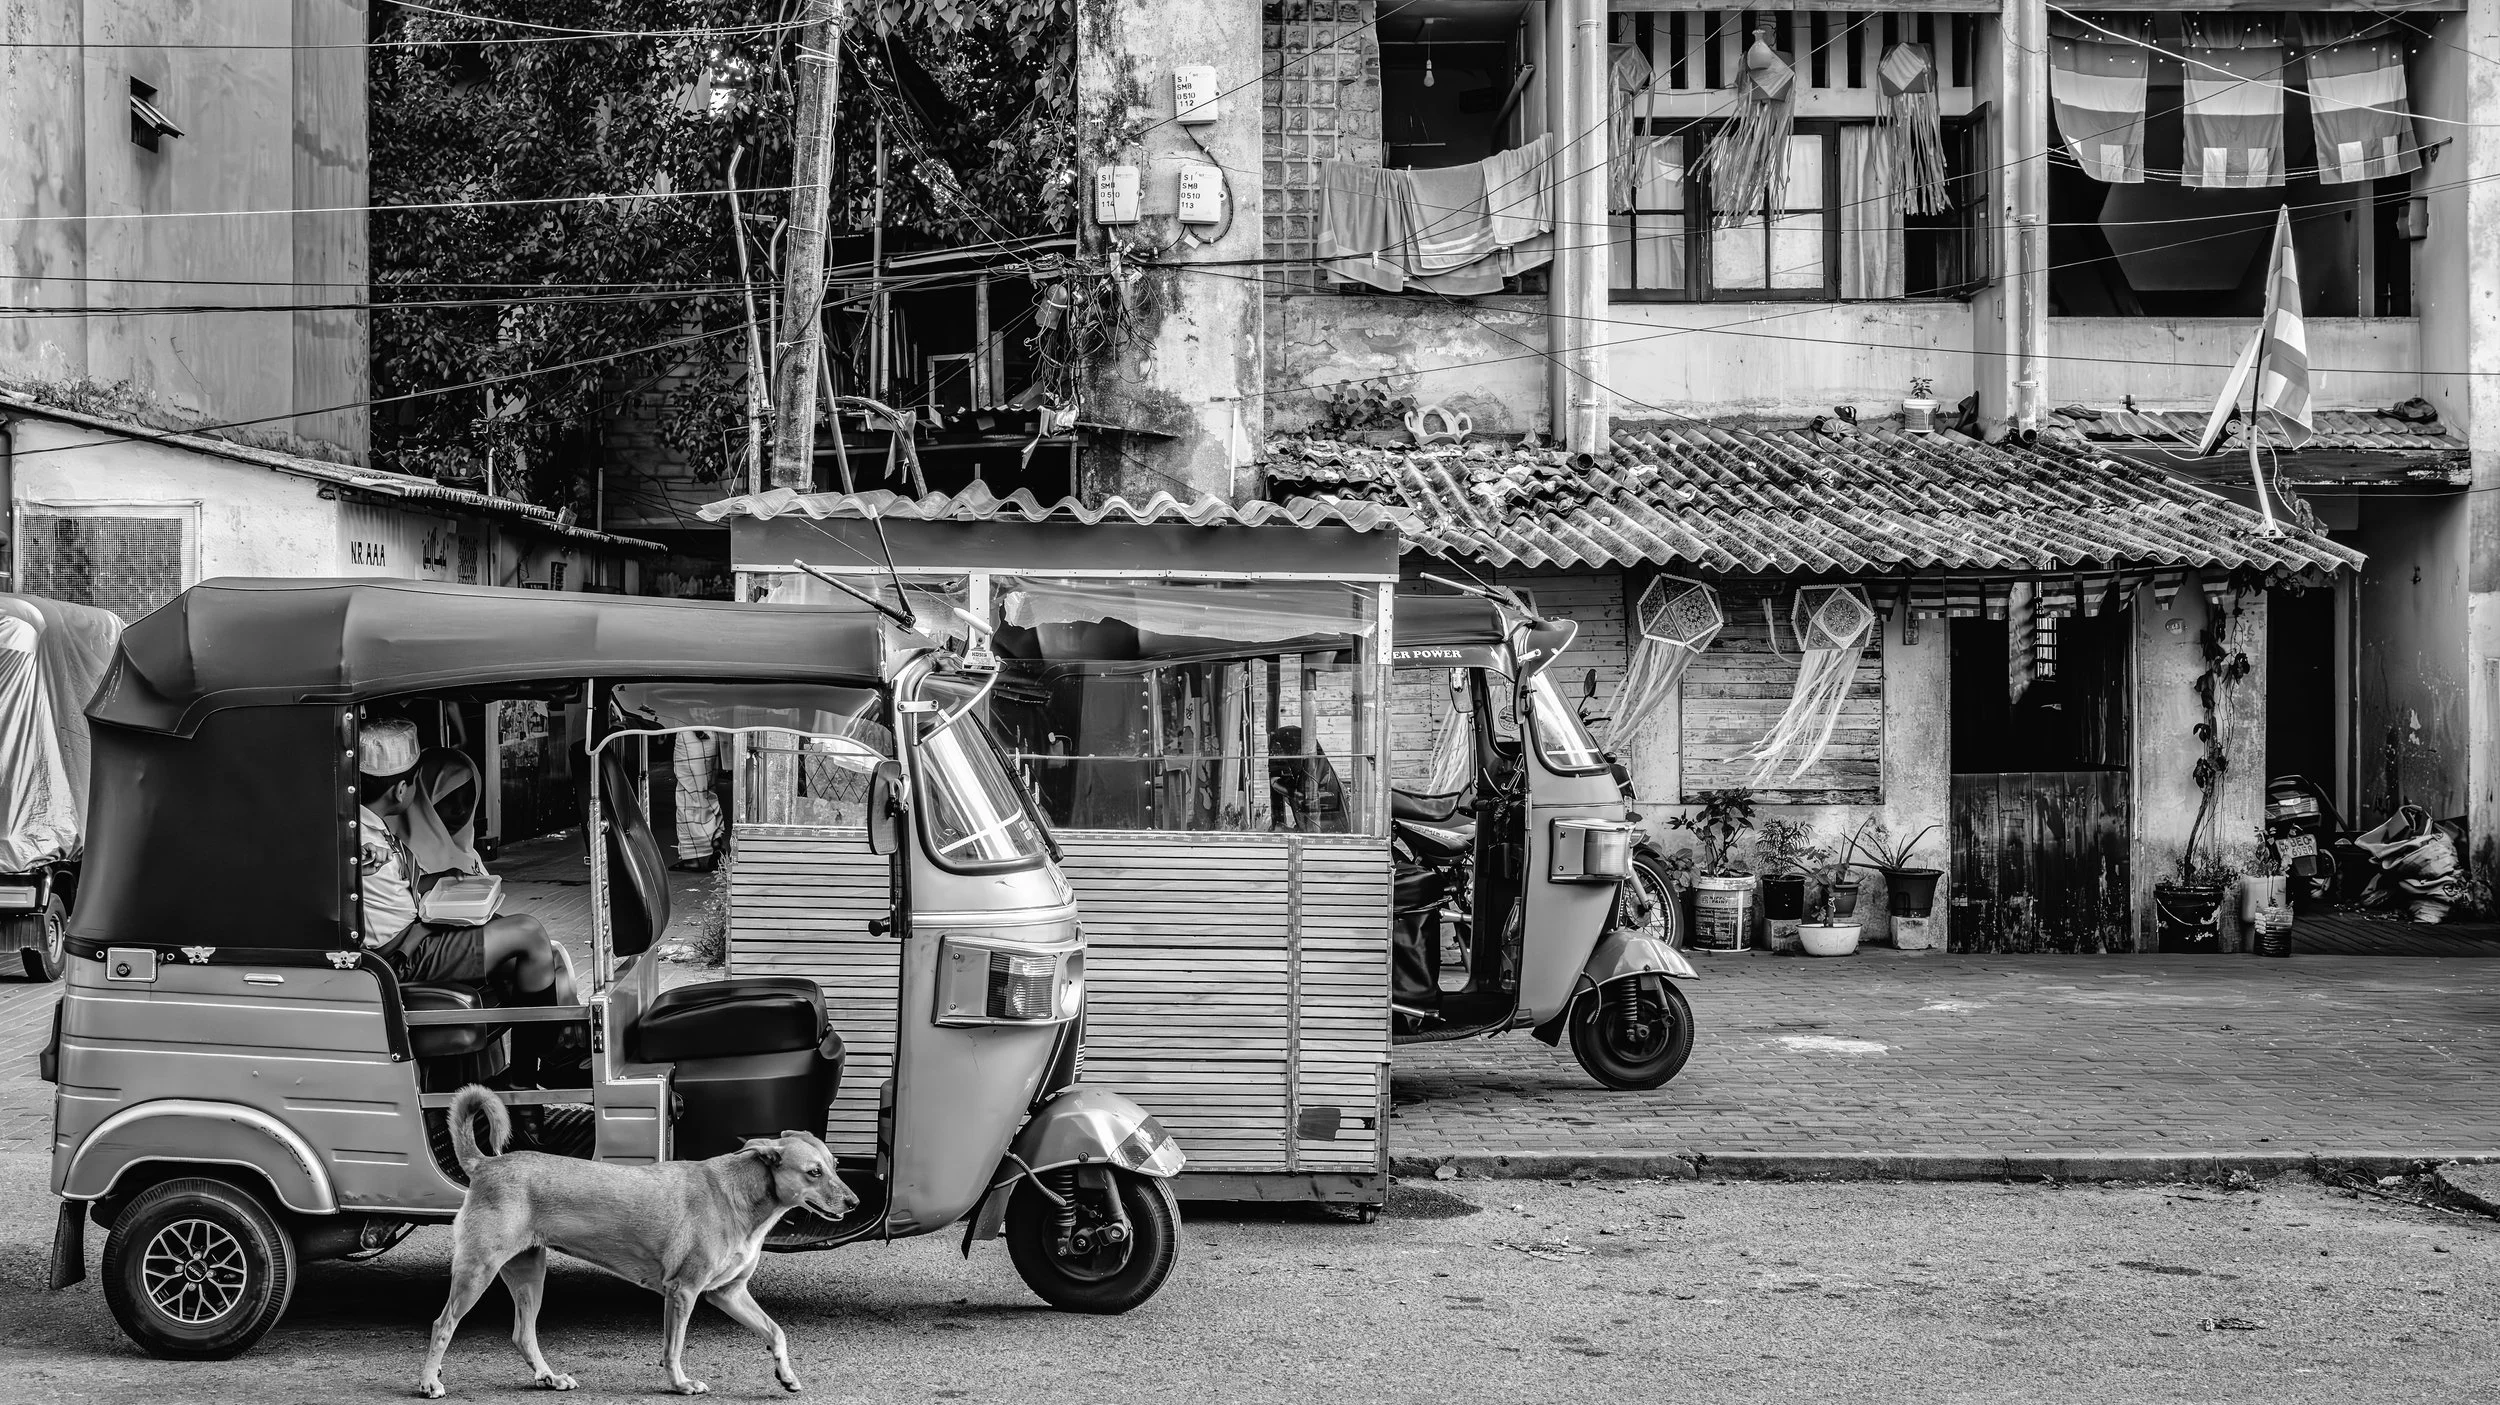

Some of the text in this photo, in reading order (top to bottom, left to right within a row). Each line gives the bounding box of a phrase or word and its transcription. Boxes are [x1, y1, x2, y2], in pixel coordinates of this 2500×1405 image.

[1177, 92, 1196, 100] 0510
[1181, 191, 1200, 200] 0510
[1181, 201, 1194, 209] 113
[1412, 649, 1462, 659] POWER
